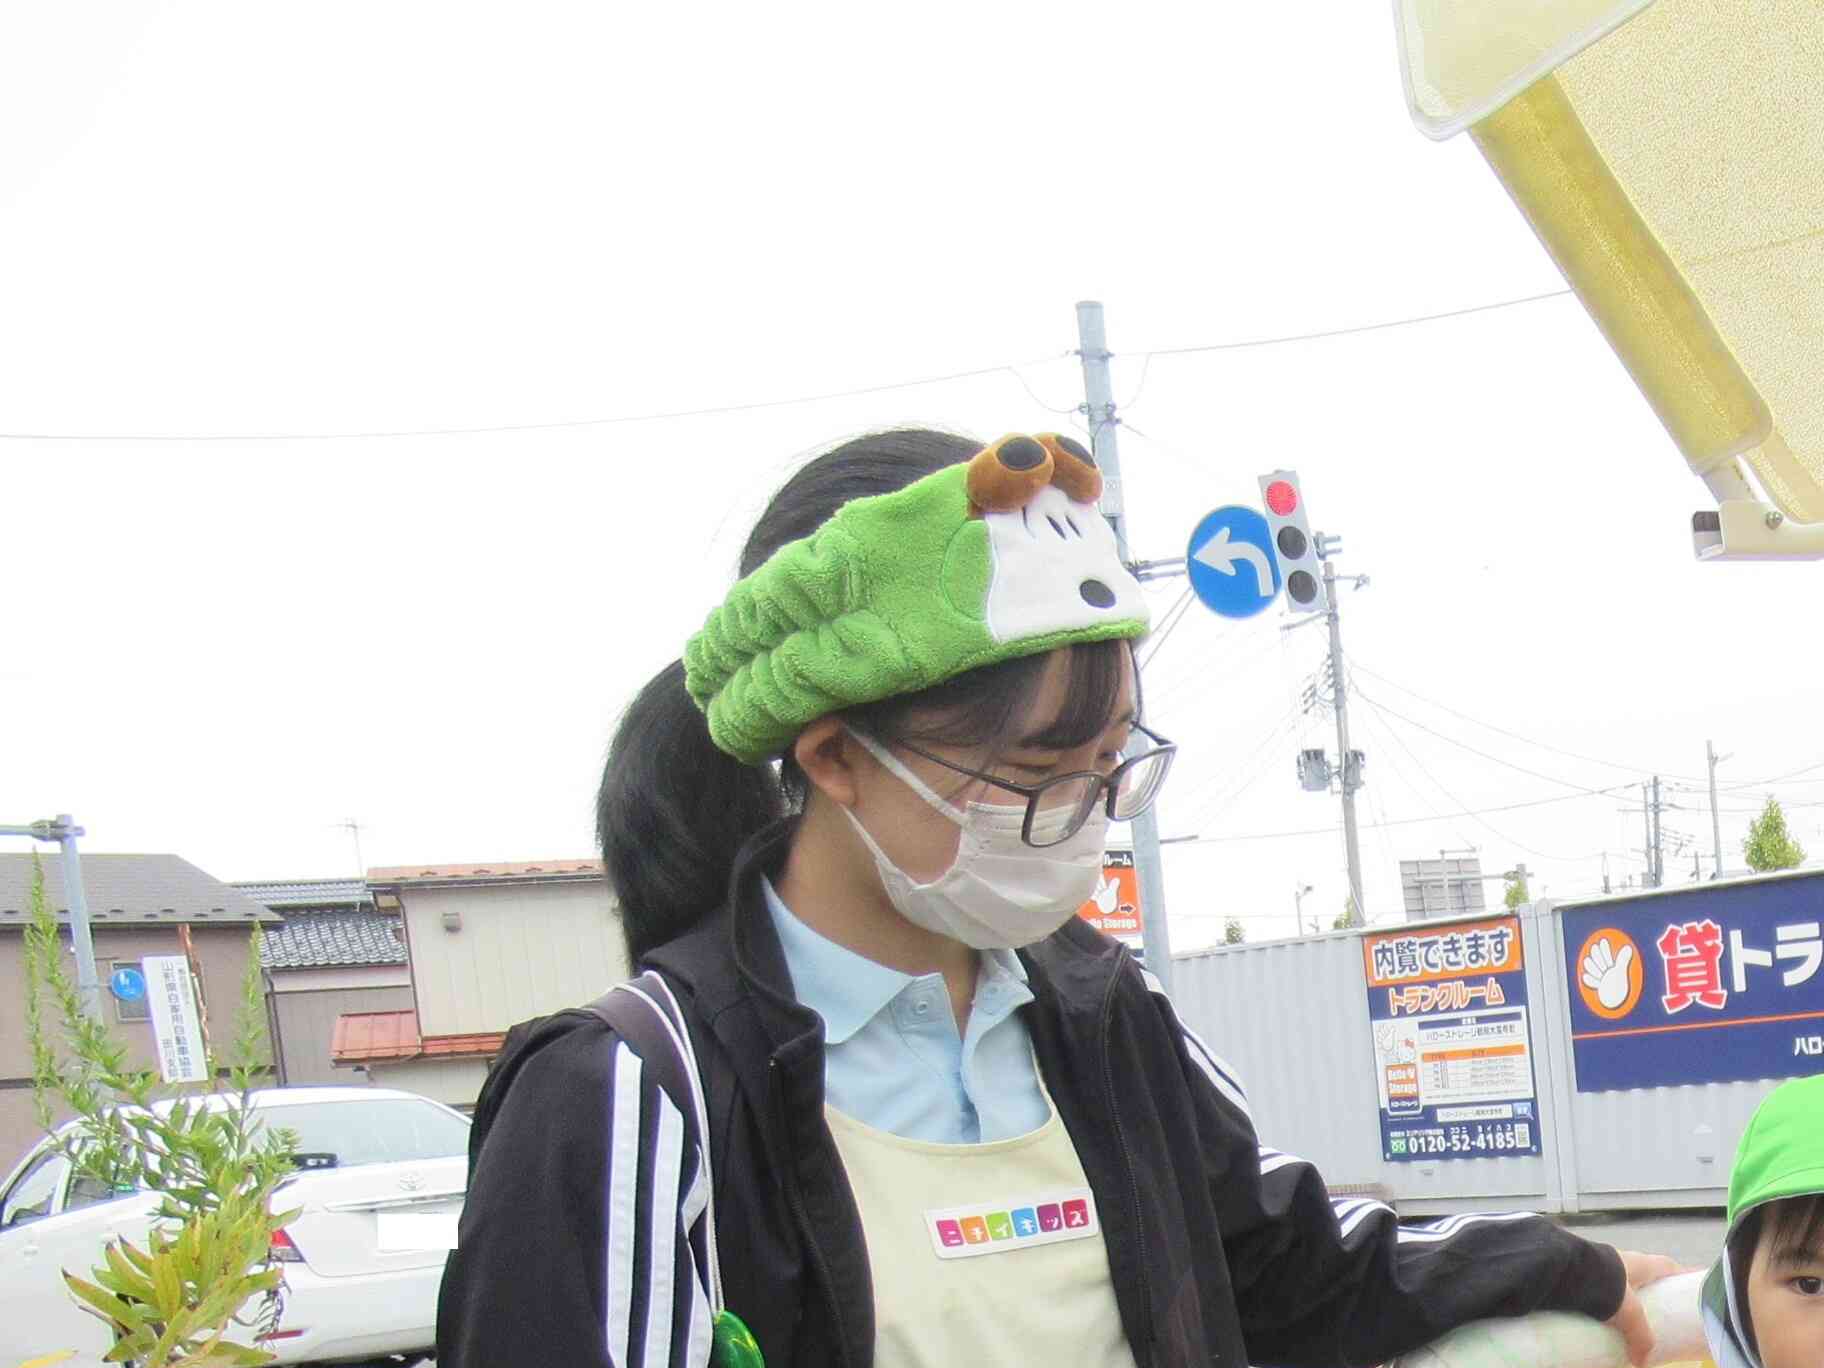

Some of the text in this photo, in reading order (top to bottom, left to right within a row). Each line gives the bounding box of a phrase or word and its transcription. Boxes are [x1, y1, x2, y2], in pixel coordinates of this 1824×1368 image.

[1374, 928, 1513, 979] 内覧できます
[1388, 978, 1505, 1017] トランクルーム
[1409, 1132, 1515, 1153] 0120-52-4185
[947, 1207, 1087, 1245] ニチイキッズ
